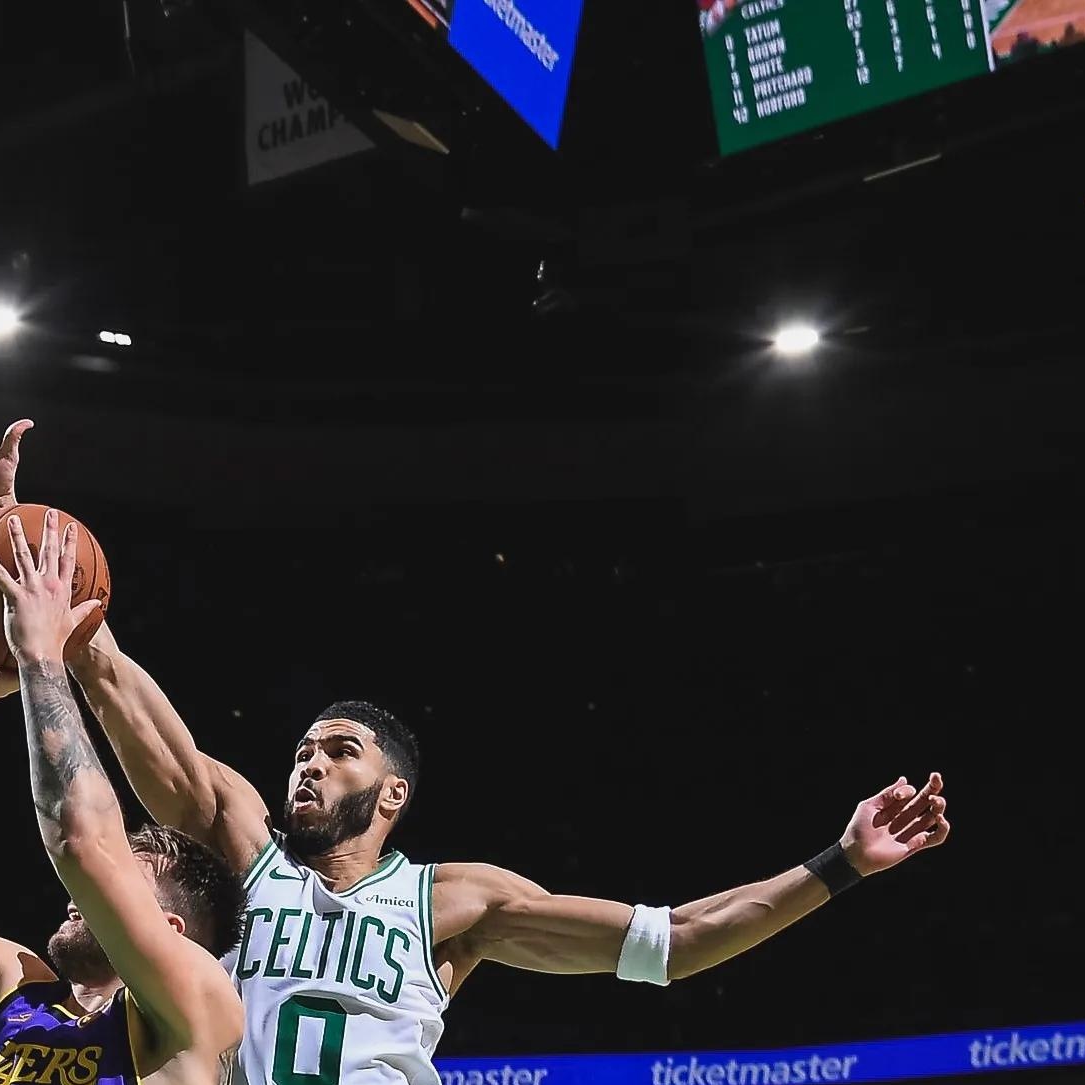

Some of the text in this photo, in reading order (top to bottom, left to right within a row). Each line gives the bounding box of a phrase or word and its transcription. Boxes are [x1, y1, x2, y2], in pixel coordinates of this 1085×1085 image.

[753, 66, 813, 101] PRITCHARD
[365, 893, 415, 908] Amica
[235, 907, 411, 1005] CELTICS
